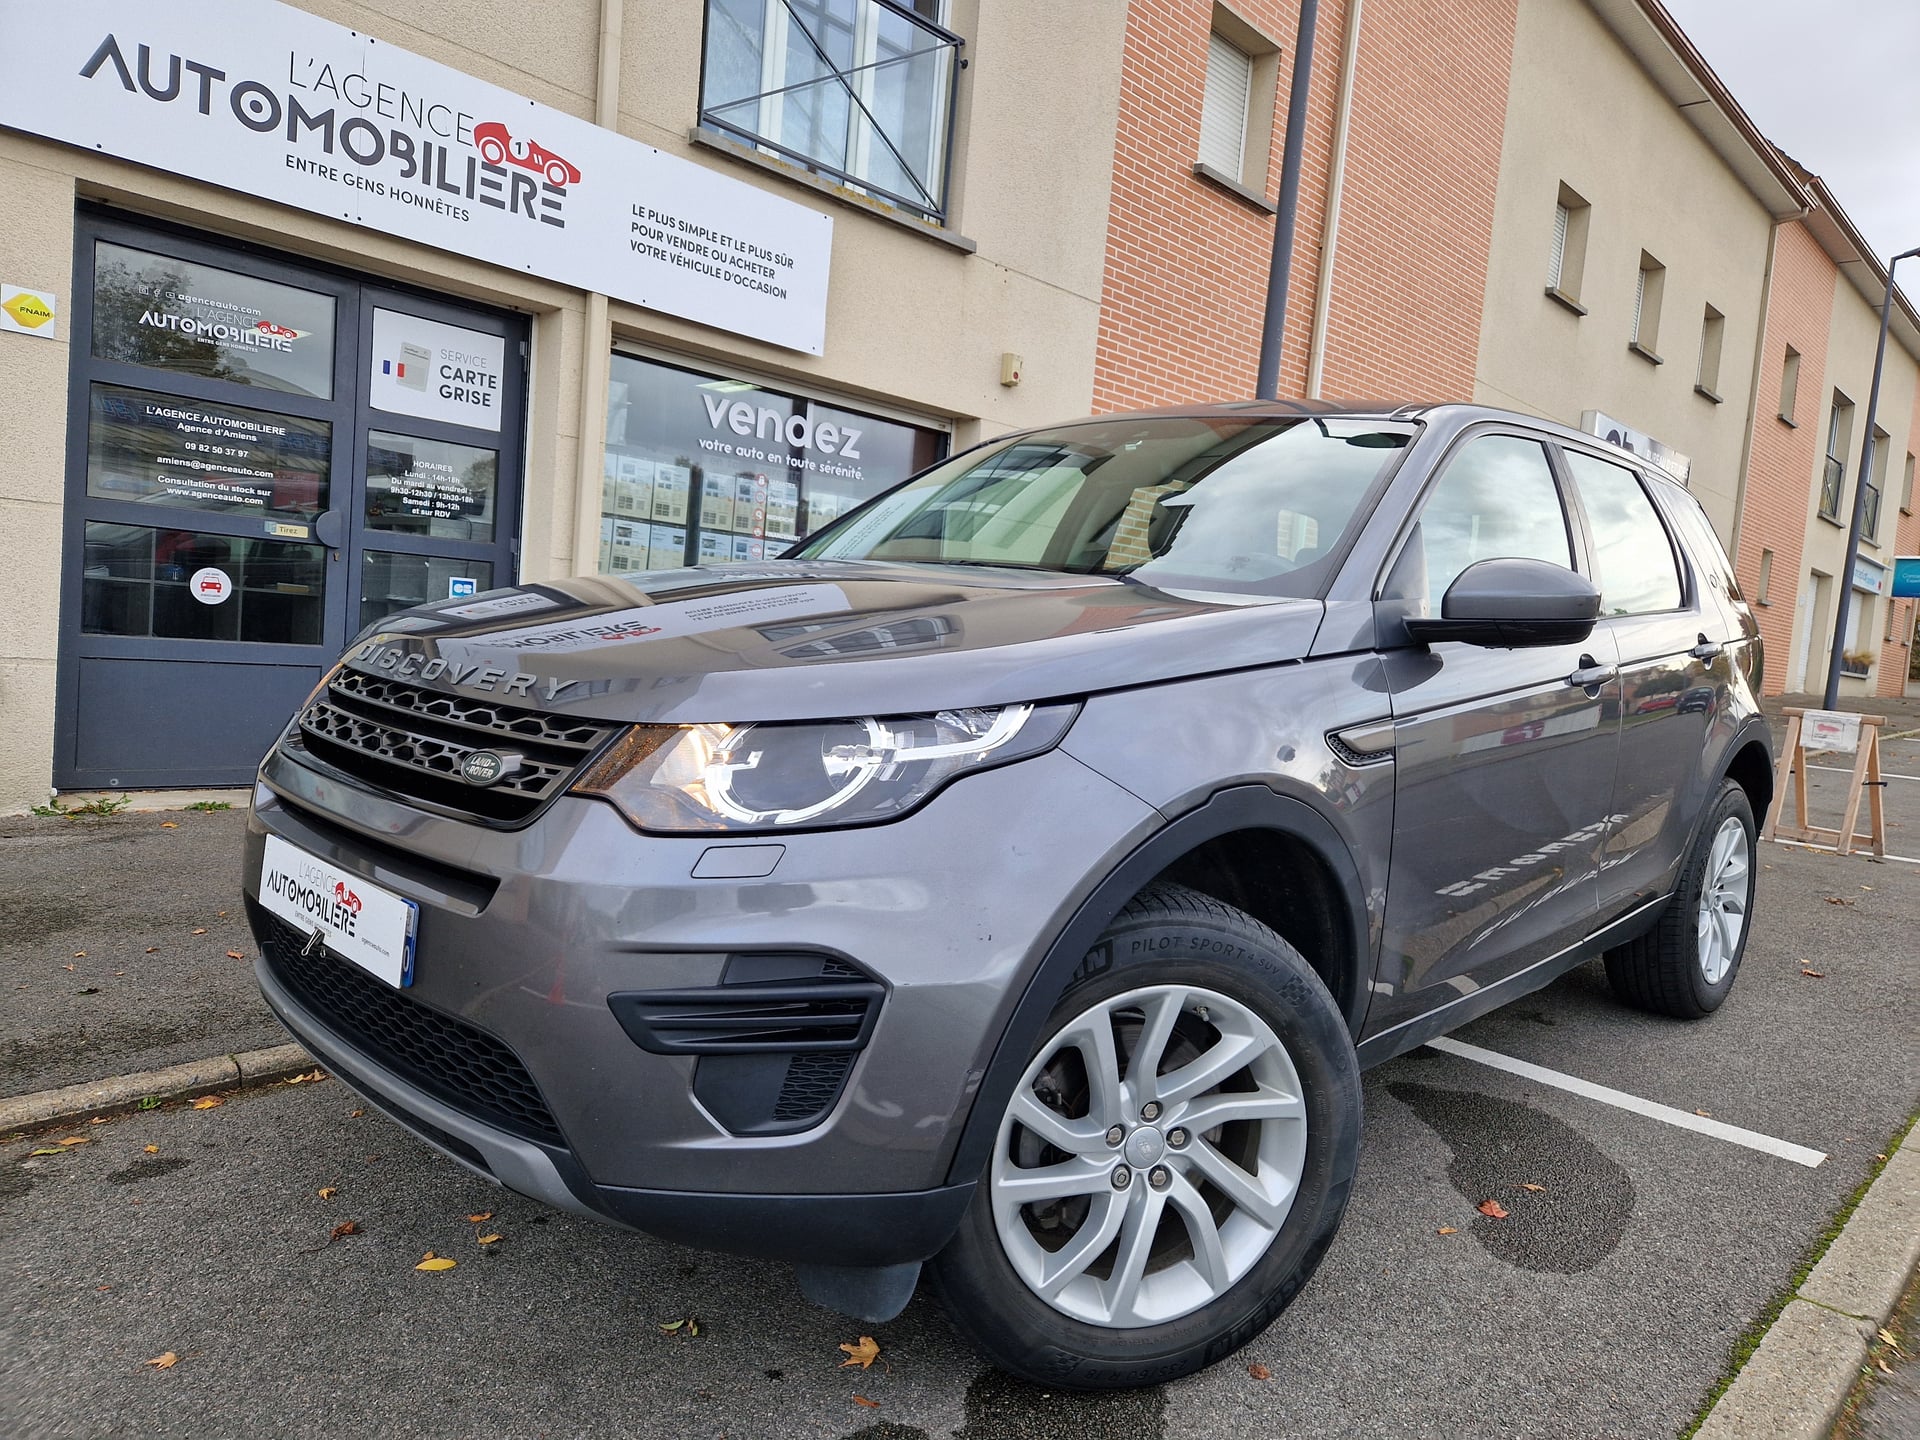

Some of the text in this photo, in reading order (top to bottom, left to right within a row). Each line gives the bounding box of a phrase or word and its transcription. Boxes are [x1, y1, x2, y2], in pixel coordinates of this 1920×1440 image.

[289, 50, 474, 146] L'AGENCE
[286, 154, 470, 222] ENTRE GENS HONNÊTES
[632, 204, 794, 269] LE PLUS SIMPLE ET LE PLUS SÛR
[630, 239, 667, 261] VOTRE
[669, 252, 721, 279] VÉHICULE
[631, 222, 775, 279] POUR VENDRE OU ACHETER
[19, 306, 50, 318] FNAIM
[178, 293, 262, 316] agenceauto.com
[440, 348, 487, 368] SERVICE
[439, 364, 497, 390] CARTE
[439, 384, 491, 407] GRISE
[146, 405, 286, 436] L'AGENCE AUTOMOBILIERE
[701, 394, 863, 460] vendez
[177, 422, 258, 442] Agence d'Amiens
[185, 442, 249, 458] 09 82 50 37 97
[698, 438, 733, 456] votre
[735, 445, 764, 461] auto
[767, 451, 782, 465] en
[785, 453, 816, 471] toute
[156, 456, 274, 479] amiens@agenceauto.com
[404, 470, 426, 479] Lundi
[413, 460, 454, 473] HORAIRES
[158, 475, 272, 497] Consultation du stock sur
[167, 487, 264, 505] www.agenceauto.com
[391, 477, 402, 485] Du
[403, 480, 425, 488] mardi
[436, 484, 468, 494] vendredi
[402, 497, 430, 507] Samedi
[434, 510, 451, 518] RDV
[280, 526, 298, 535] Tirez
[355, 643, 579, 701] DISCOVERY
[468, 765, 494, 779] ROVER
[471, 756, 492, 768] LAND
[1131, 936, 1184, 954] PILOT
[1190, 936, 1246, 959] SPORT
[1257, 957, 1280, 976] SUV
